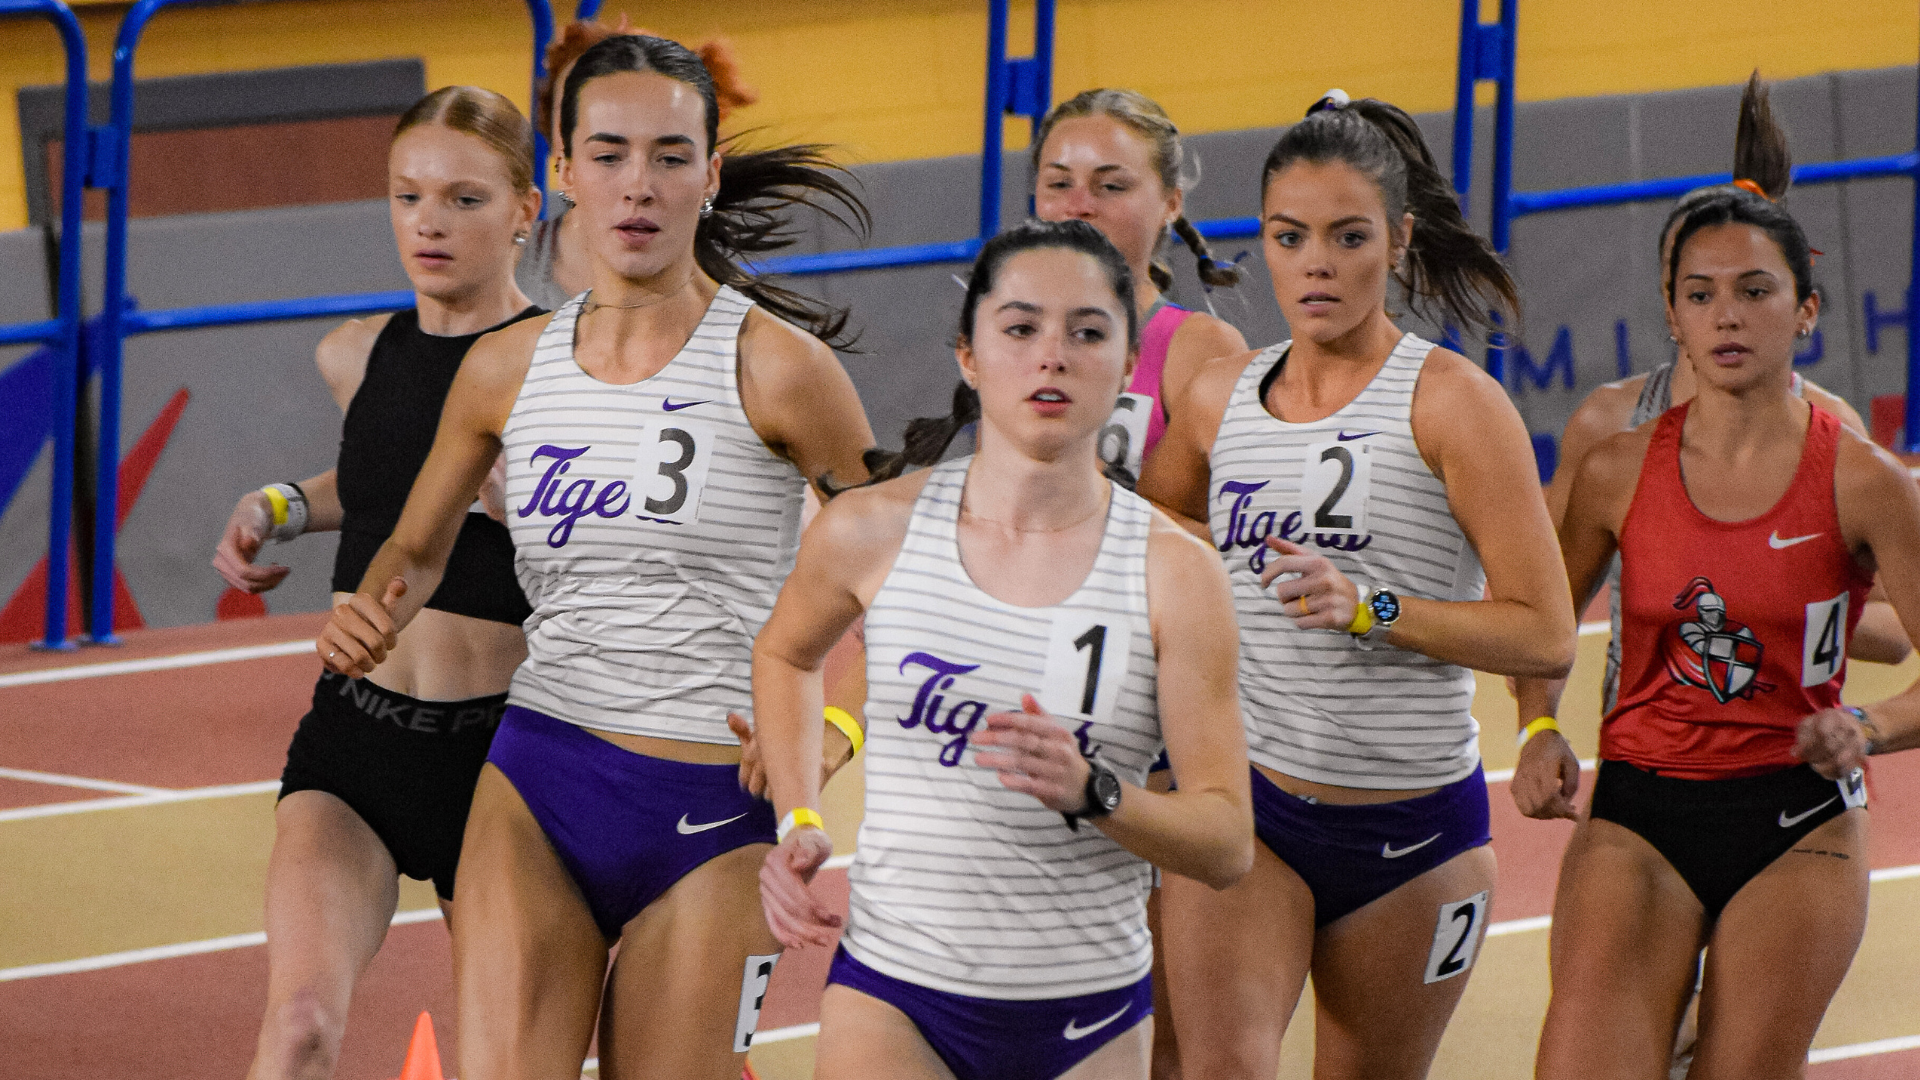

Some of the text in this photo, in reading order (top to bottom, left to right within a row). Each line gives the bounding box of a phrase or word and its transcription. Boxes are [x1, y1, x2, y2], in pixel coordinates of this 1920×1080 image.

[517, 444, 684, 549] Tige
[644, 428, 696, 515] 3
[1315, 446, 1354, 529] 2
[1073, 624, 1108, 716] 1
[1813, 602, 1840, 675] 4
[339, 678, 446, 733] NIKE
[897, 652, 1101, 767] Tig
[1436, 902, 1476, 977] 2
